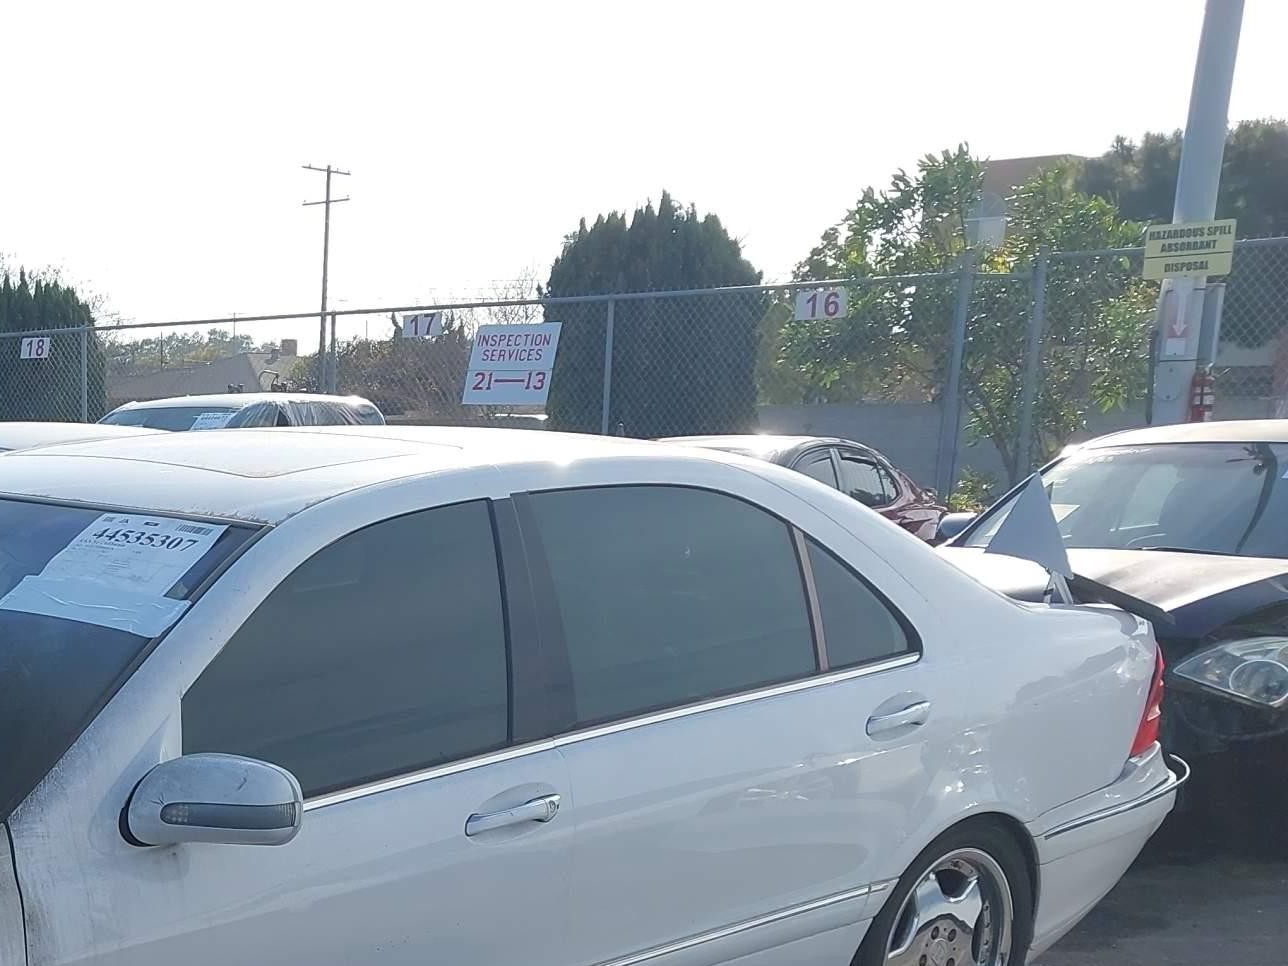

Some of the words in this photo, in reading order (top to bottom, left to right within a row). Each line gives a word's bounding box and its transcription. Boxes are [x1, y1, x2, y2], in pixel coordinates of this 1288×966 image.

[1149, 226, 1206, 241] HAZARDOUS
[1207, 224, 1233, 237] SPILL
[1164, 260, 1210, 273] DISPOSAL
[806, 291, 841, 318] 16
[410, 312, 436, 336] 17
[26, 338, 45, 357] 18
[477, 333, 552, 347] INSPECTION
[481, 348, 543, 362] SERVICES
[92, 527, 199, 552] 44535307
